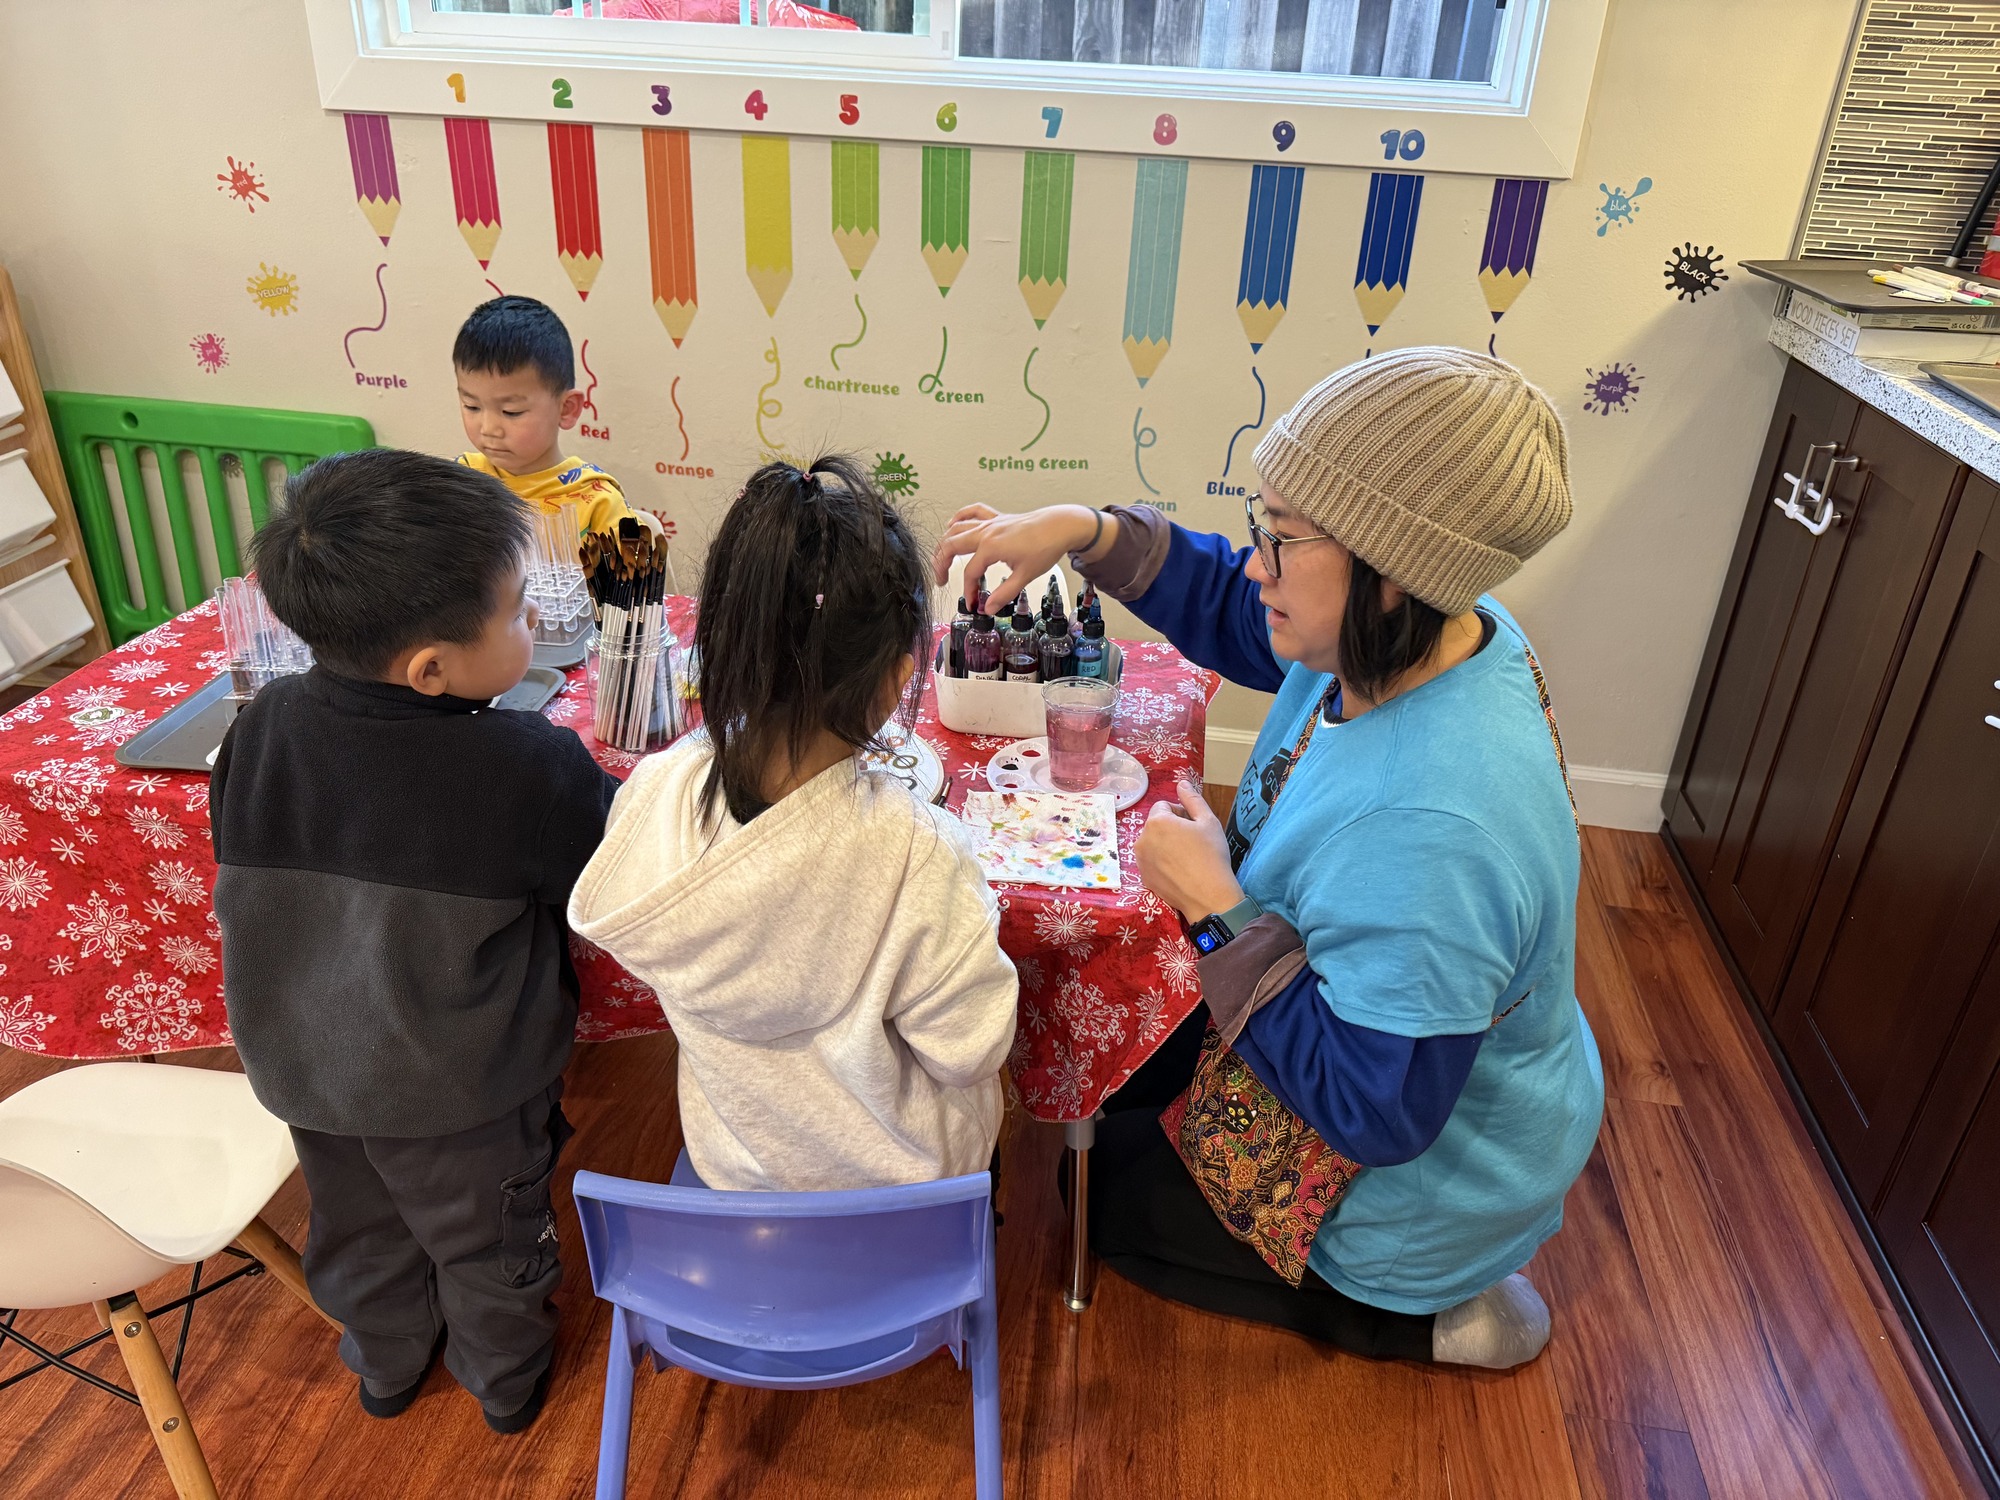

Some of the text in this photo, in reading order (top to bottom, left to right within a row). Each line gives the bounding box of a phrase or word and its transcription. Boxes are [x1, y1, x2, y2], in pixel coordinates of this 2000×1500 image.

[447, 73, 1426, 161] 1 2 3 4 5 6 7 8 9 10
[1609, 199, 1627, 211] blue
[1679, 261, 1710, 284] BLACK
[257, 284, 290, 298] YELLOW
[1790, 299, 1813, 325] WOOD
[1840, 325, 1857, 350] SET
[355, 372, 408, 389] Purple
[804, 375, 900, 396] Chartreuse
[1600, 382, 1624, 394] purple
[935, 390, 985, 404] Green
[581, 424, 610, 441] Red
[655, 461, 715, 479] Orange
[978, 456, 1089, 472] Spring Green
[878, 472, 907, 482] GREEN
[1206, 481, 1246, 497] Blue
[1134, 499, 1177, 512] an
